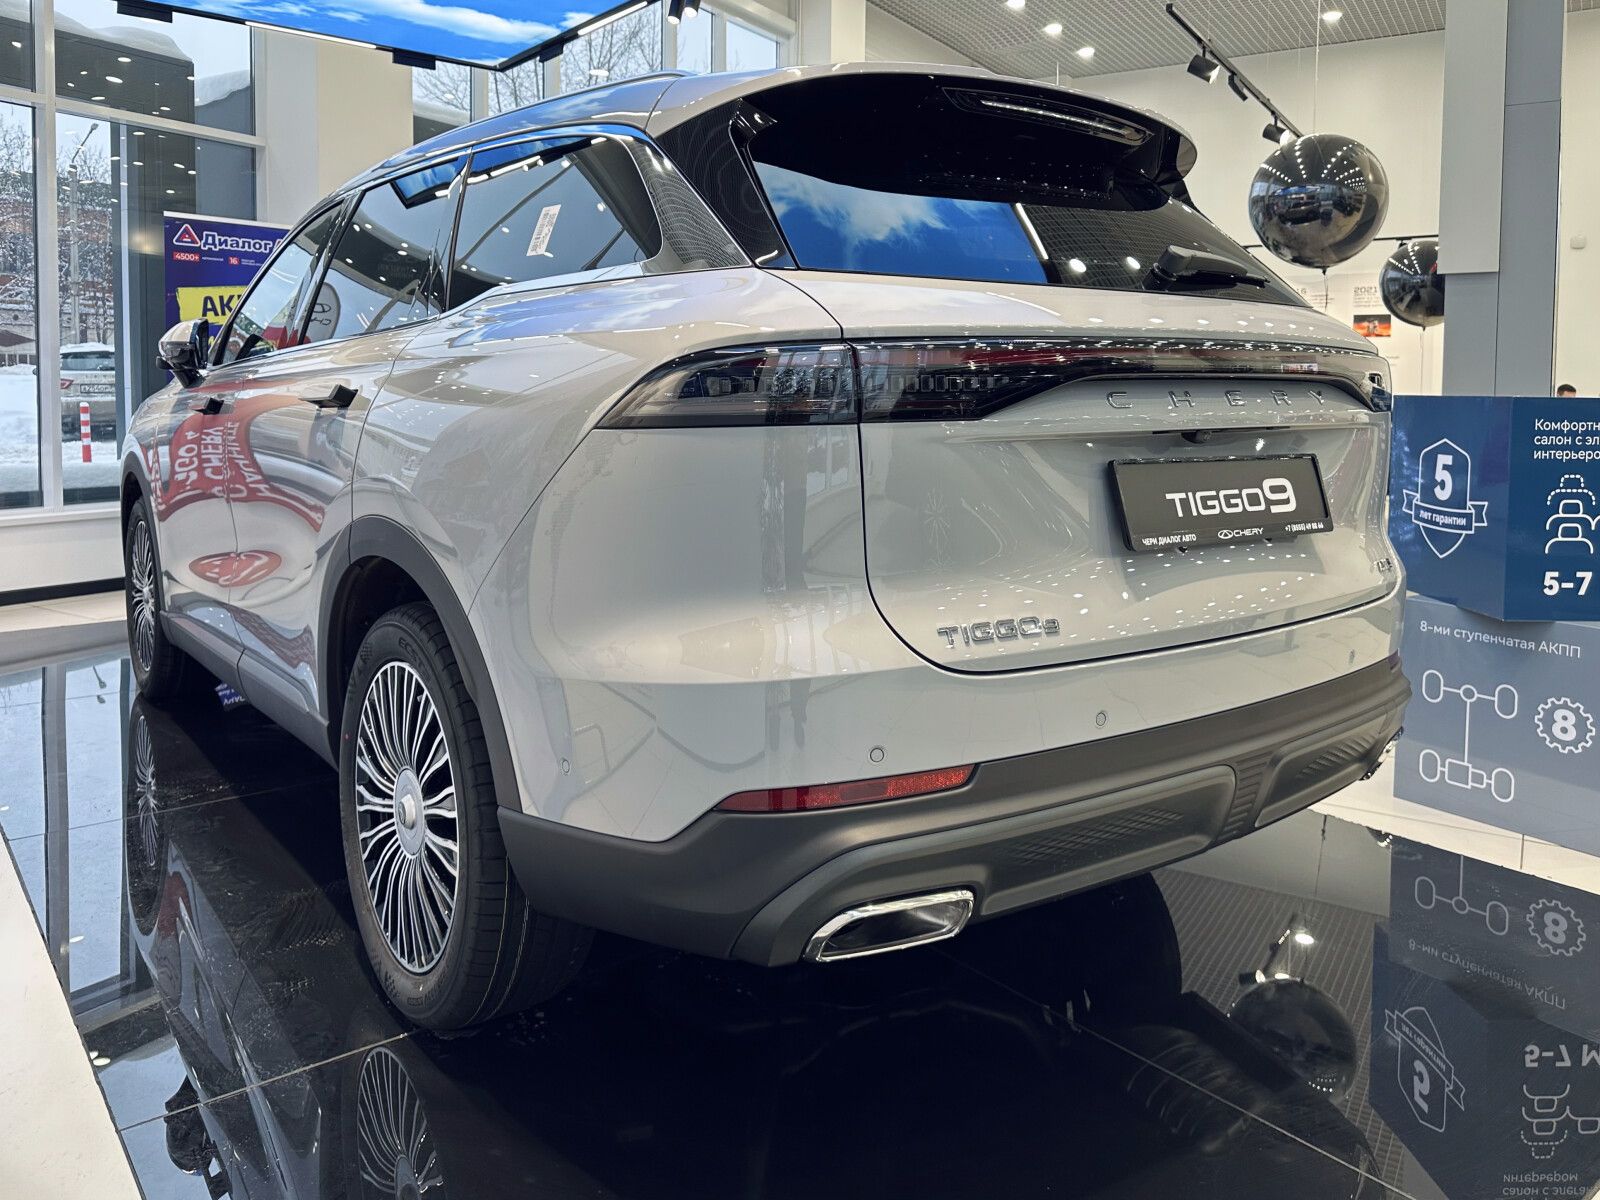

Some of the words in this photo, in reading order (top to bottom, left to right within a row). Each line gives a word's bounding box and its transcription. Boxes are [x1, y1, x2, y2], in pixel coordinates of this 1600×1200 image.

[201, 231, 272, 252] Диалог
[175, 252, 199, 261] 4500+
[229, 257, 238, 265] 16
[1353, 286, 1378, 294] 2021
[202, 294, 242, 317] АК
[1106, 390, 1325, 410] CHERY
[1534, 418, 1600, 434] Комфортн
[1533, 435, 1572, 445] салон
[1575, 435, 1583, 445] с
[1533, 450, 1600, 463] интерьеро
[1433, 453, 1453, 501] 5
[1165, 477, 1297, 518] TIGGO9
[1419, 510, 1432, 521] лет
[1432, 511, 1467, 526] гарантии
[1142, 536, 1158, 546] ЧЕРИ
[1158, 534, 1181, 545] ДИАЛОГ
[1182, 533, 1197, 543] АВТО
[1233, 527, 1264, 537] CHERY
[1543, 571, 1593, 596] 5-7
[1420, 620, 1450, 636] 8-ми
[1453, 628, 1535, 651] ступенчатая
[1538, 640, 1581, 659] АКПП
[1551, 708, 1577, 741] 8
